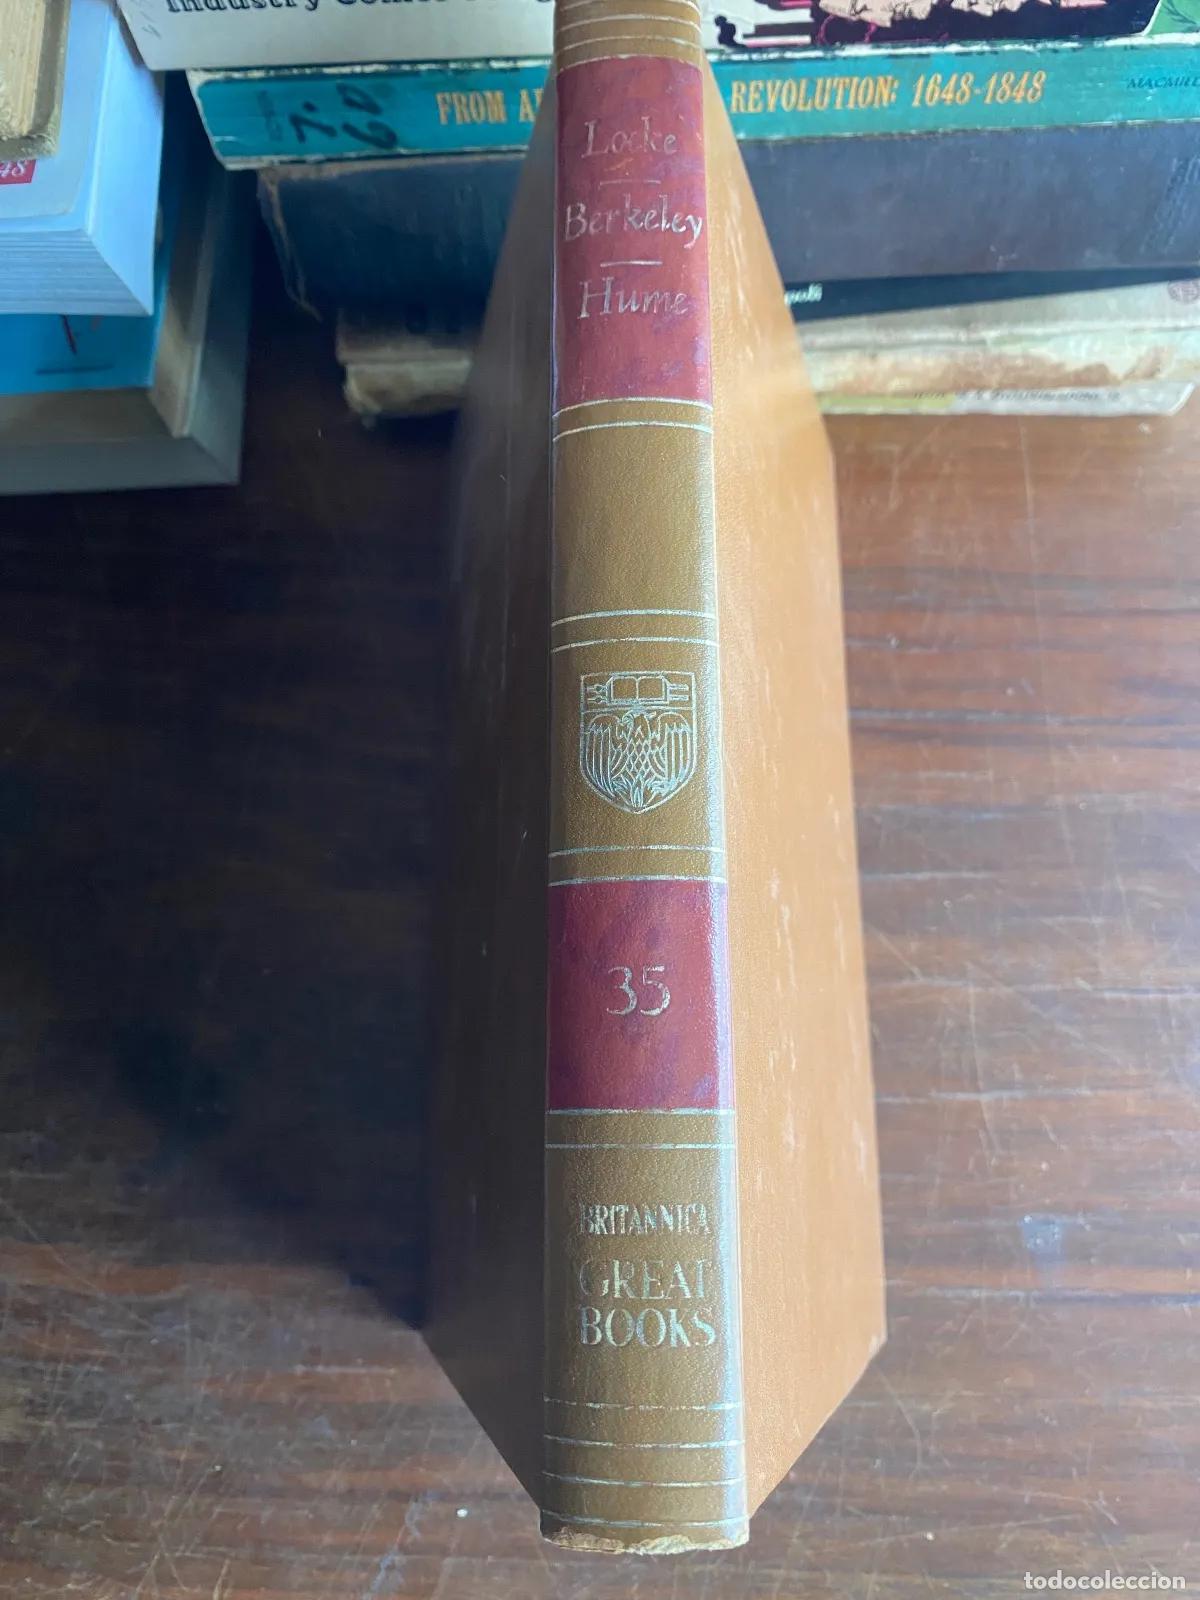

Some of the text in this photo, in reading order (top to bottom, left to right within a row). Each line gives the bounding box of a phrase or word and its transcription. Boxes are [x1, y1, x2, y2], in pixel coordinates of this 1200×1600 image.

[436, 90, 506, 125] FROM
[730, 70, 1047, 115] REVOLUTION: 1648-1848
[581, 116, 678, 159] Locke
[564, 193, 703, 249] Berkeley
[577, 276, 688, 320] Hume
[605, 964, 671, 1016] 35
[578, 1202, 710, 1236] BRITANNICA
[579, 1257, 710, 1300] GREAT
[579, 1304, 717, 1347] BOOKS
